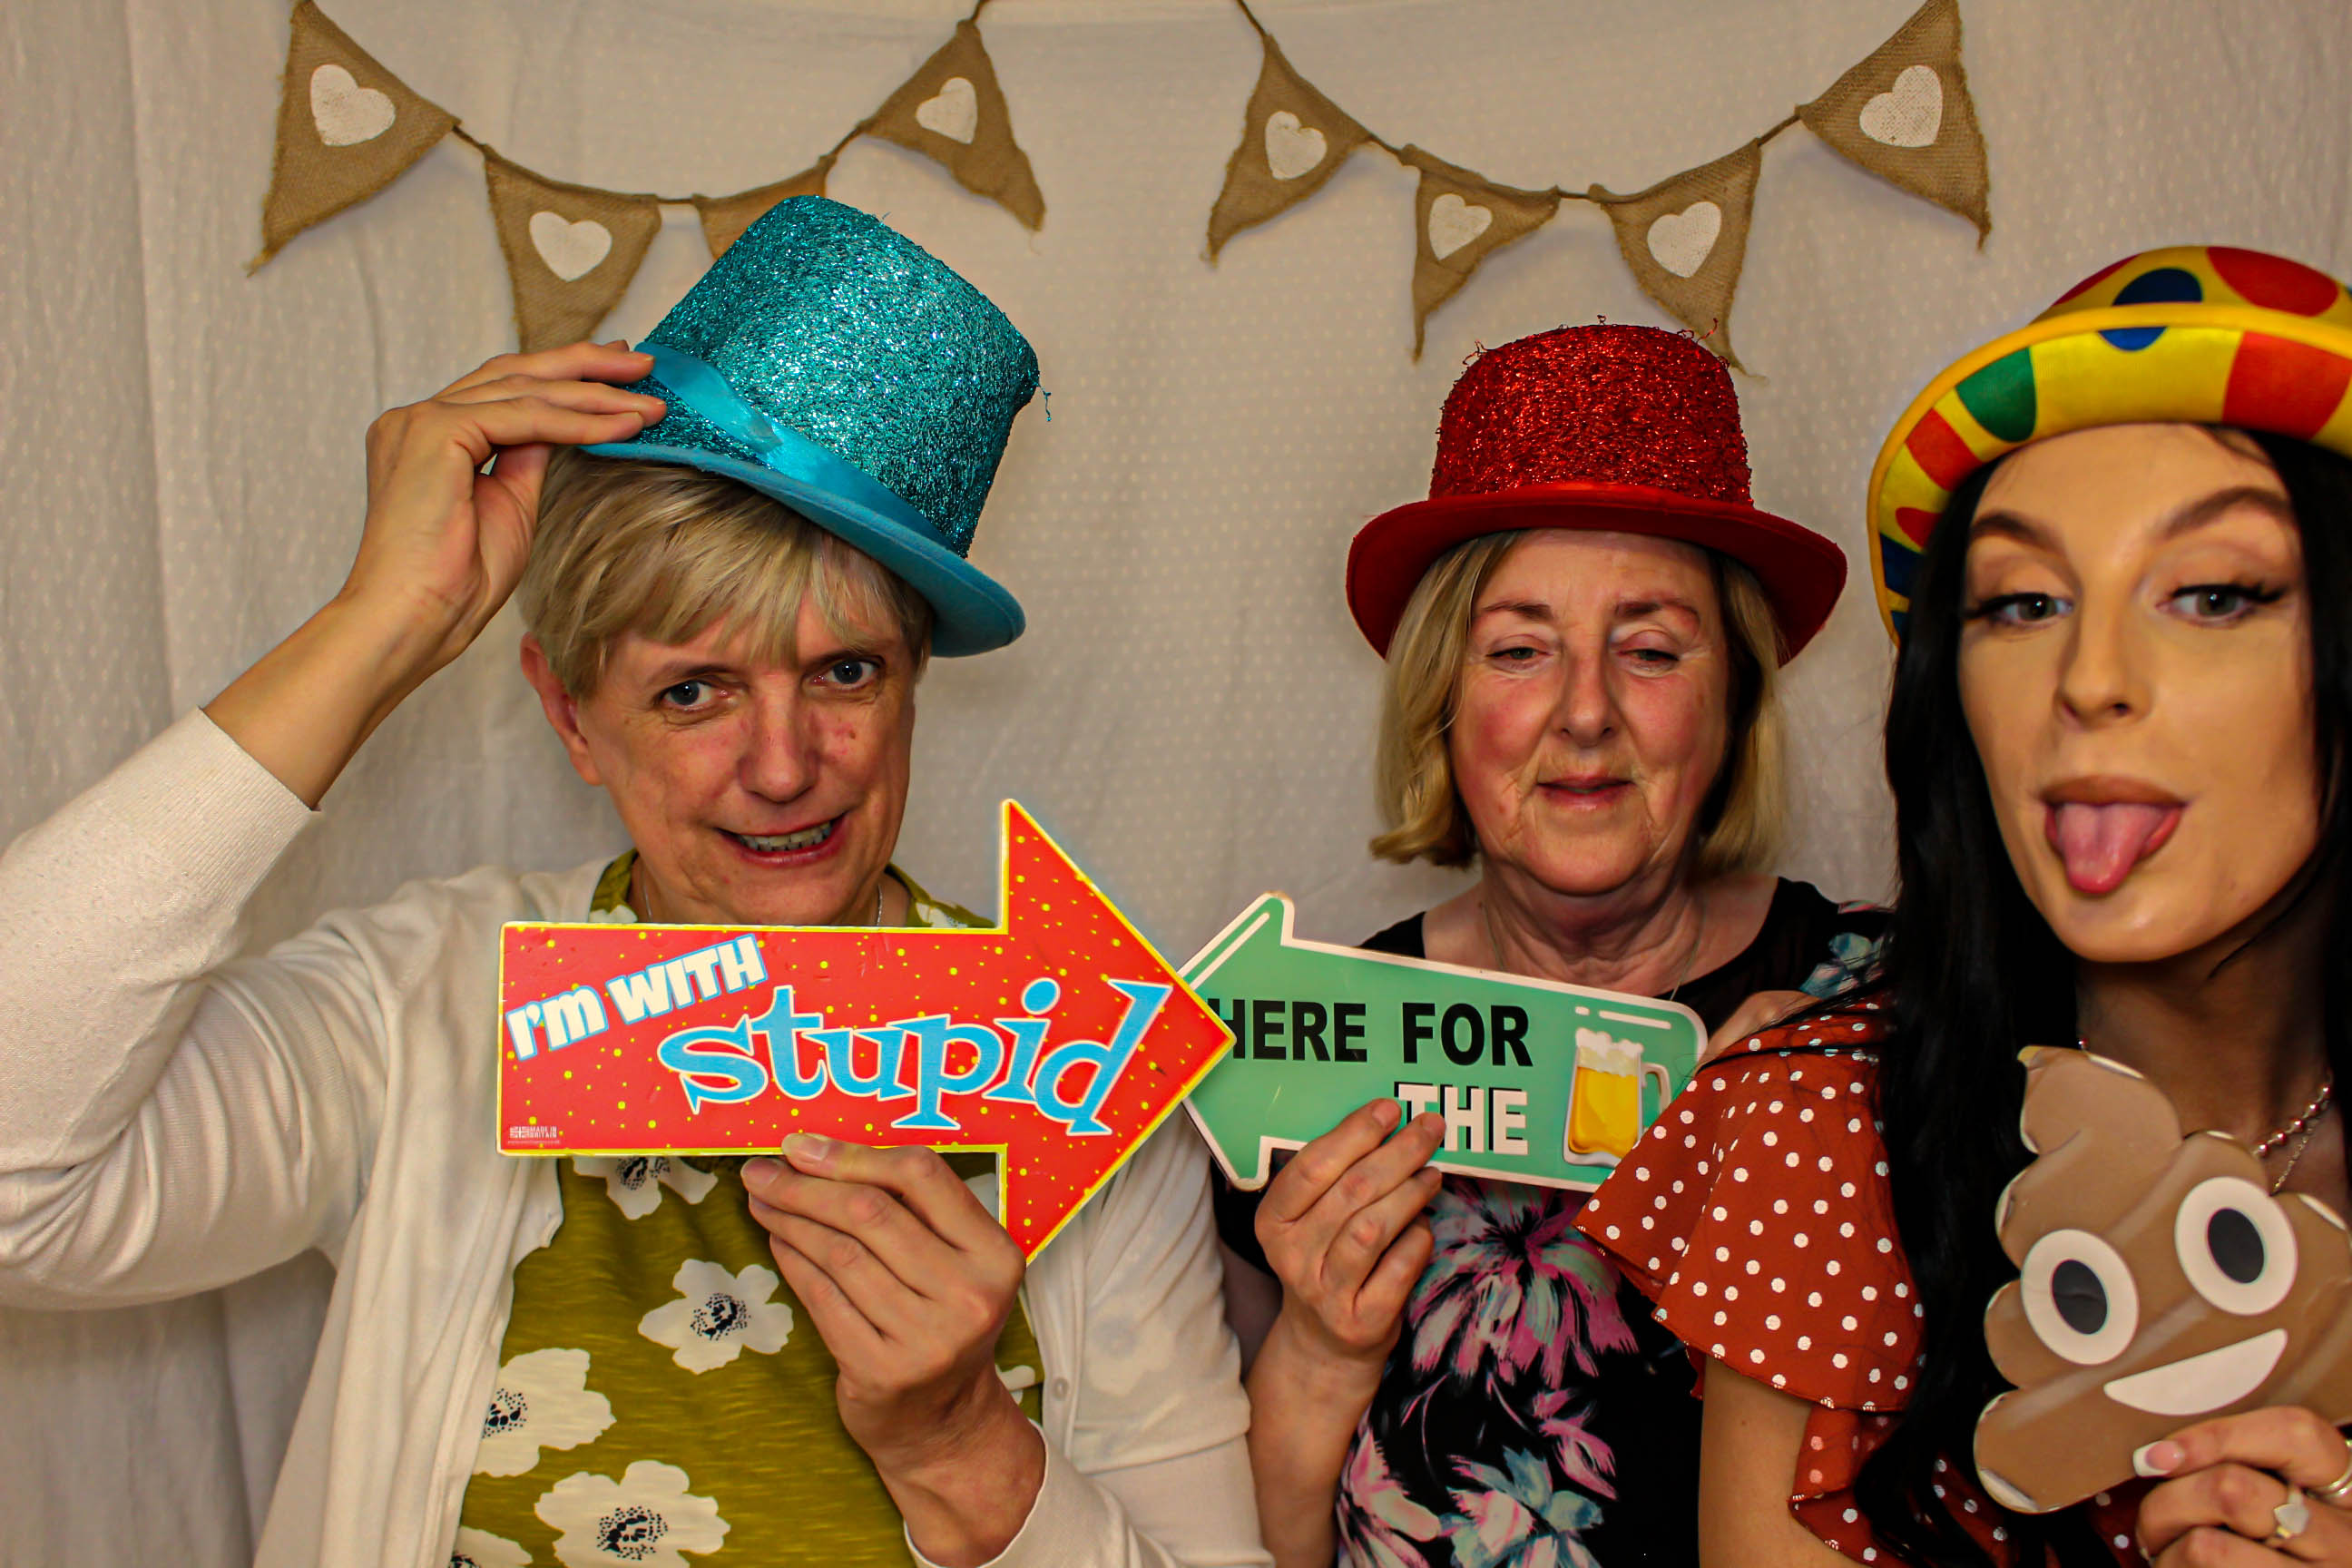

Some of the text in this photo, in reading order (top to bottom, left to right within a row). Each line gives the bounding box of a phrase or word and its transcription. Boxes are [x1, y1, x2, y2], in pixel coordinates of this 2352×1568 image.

[605, 934, 768, 1024] WITH
[658, 977, 1172, 1137] stupid
[1402, 1002, 1534, 1067] FOR
[1394, 1082, 1529, 1156] THE
